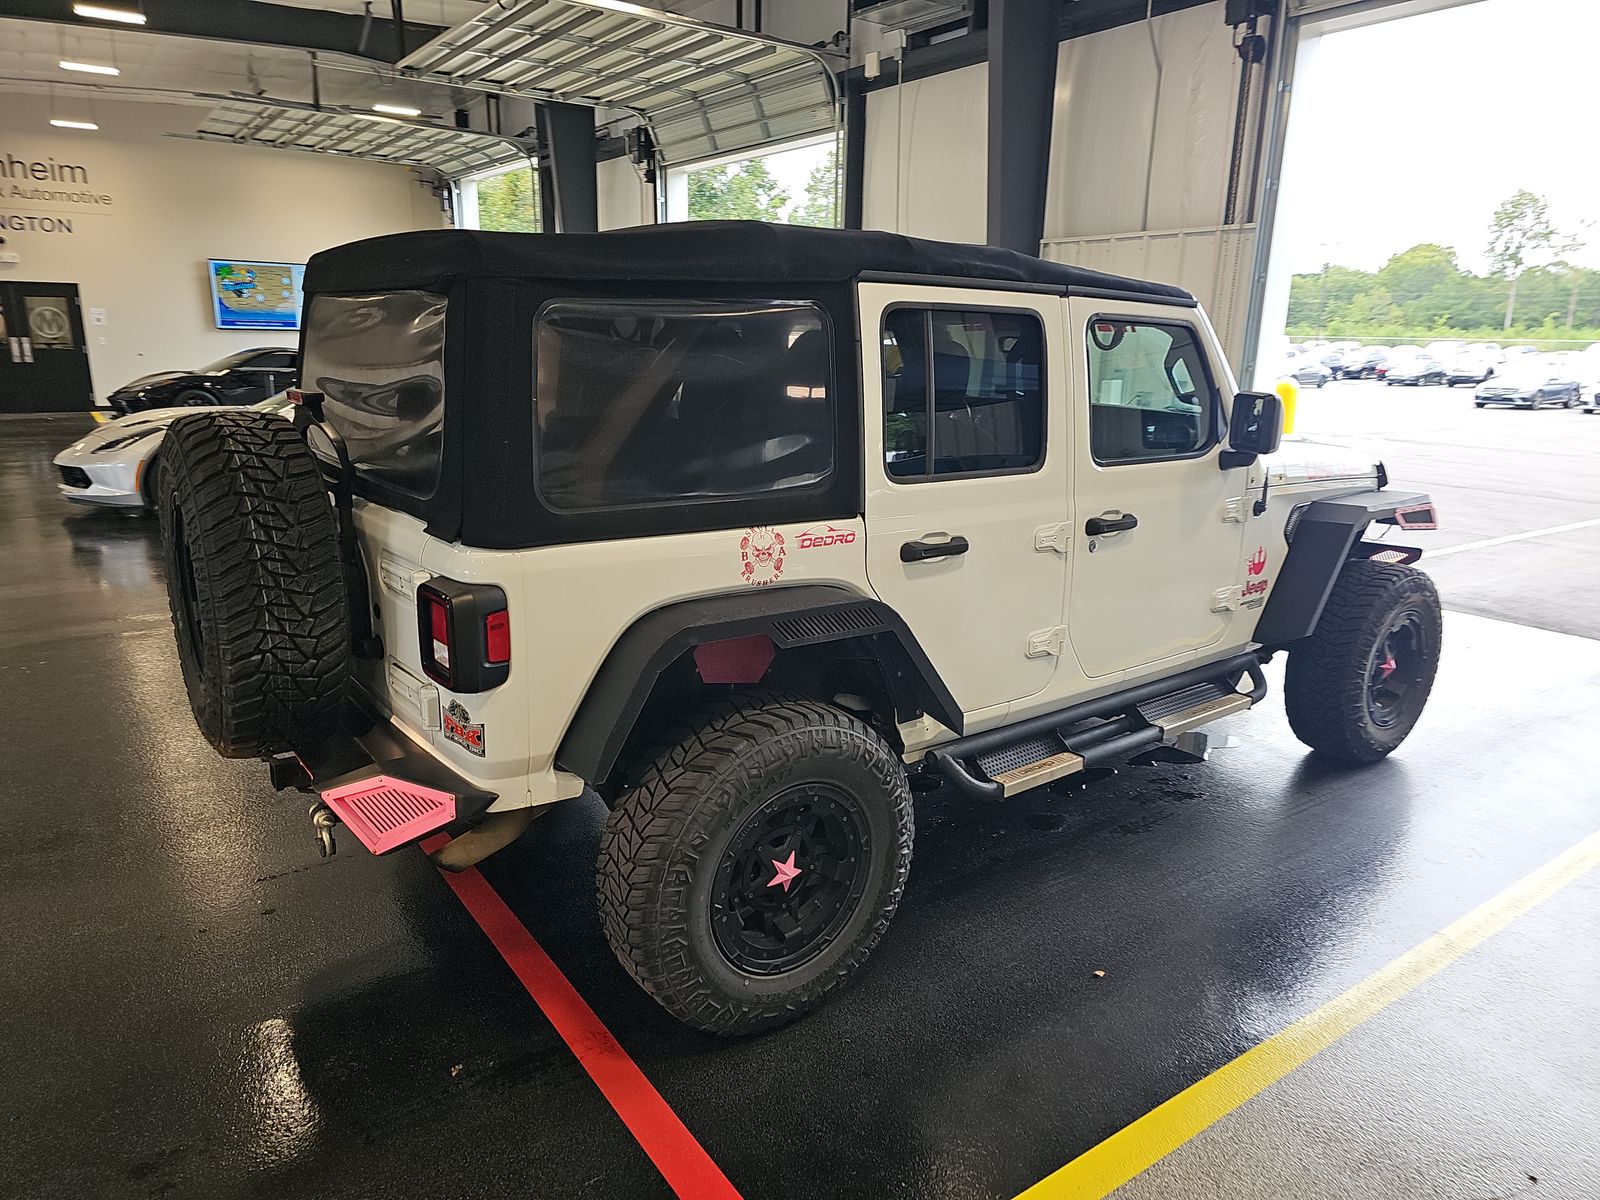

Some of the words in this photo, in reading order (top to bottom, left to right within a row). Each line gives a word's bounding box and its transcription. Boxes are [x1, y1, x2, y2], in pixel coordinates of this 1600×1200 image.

[9, 185, 113, 206] Automotive
[741, 551, 749, 561] B
[778, 546, 786, 556] A
[740, 569, 784, 586] KRUSHERS
[1241, 580, 1268, 597] Jeep
